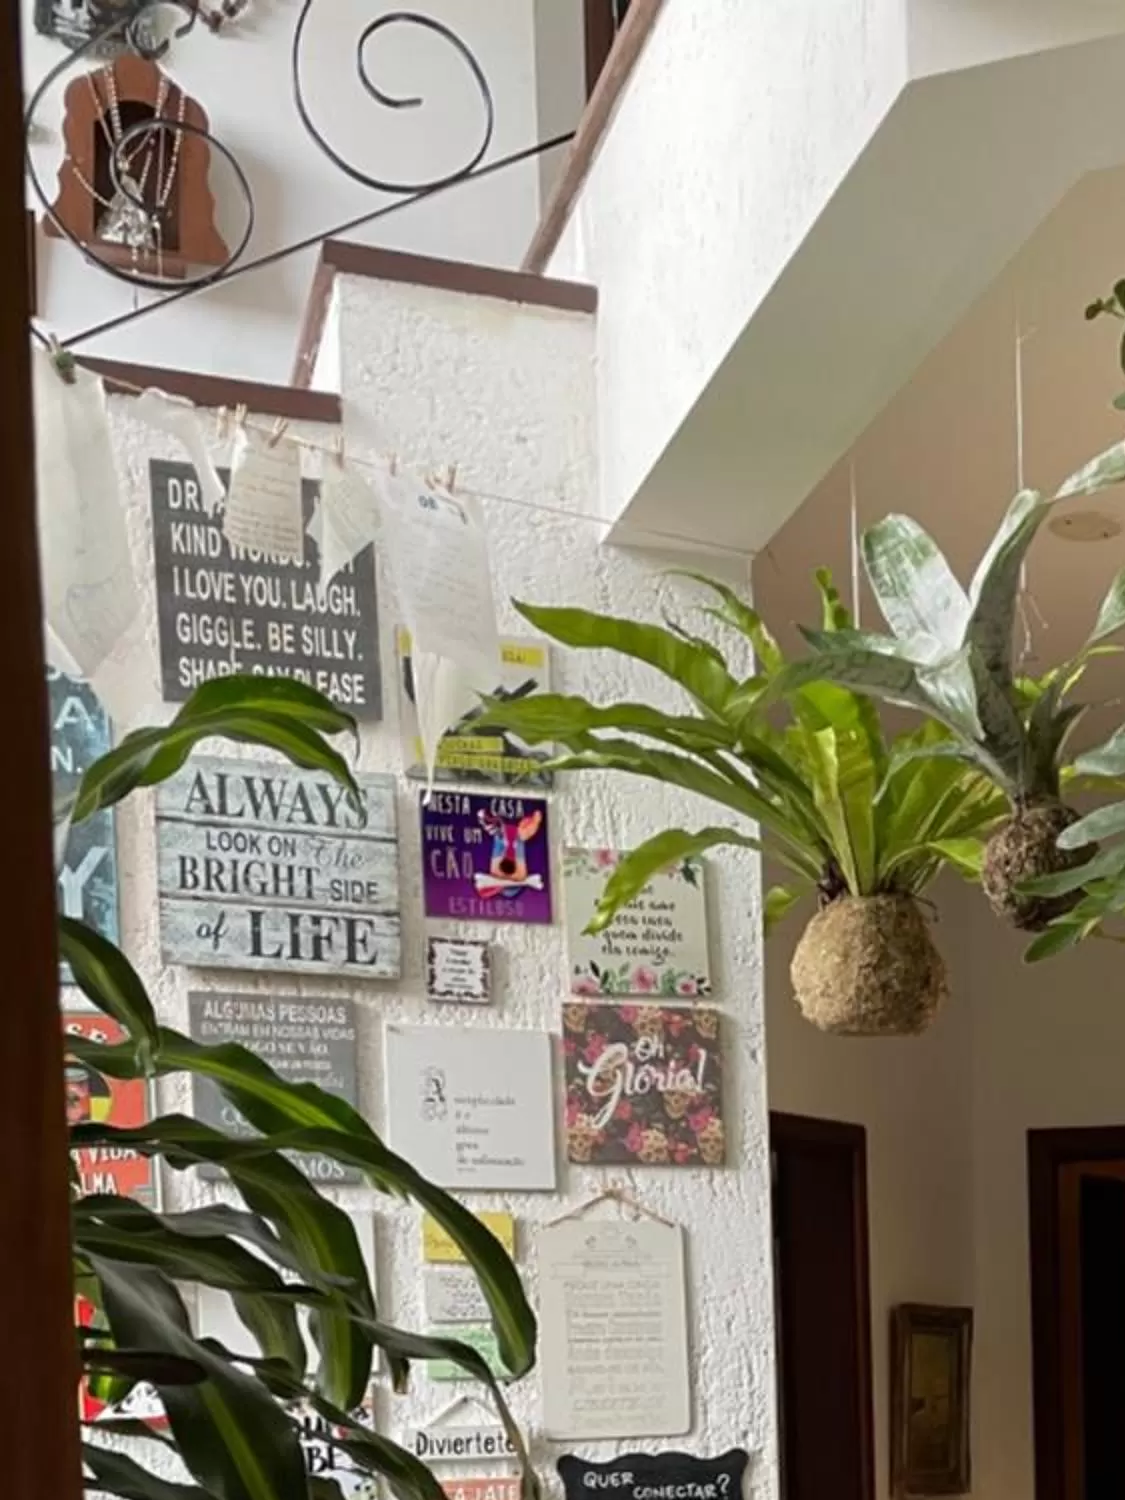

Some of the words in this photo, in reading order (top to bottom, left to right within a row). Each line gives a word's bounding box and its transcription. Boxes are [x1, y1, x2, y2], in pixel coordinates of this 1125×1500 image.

[170, 521, 222, 558] KIND
[173, 566, 180, 596] I
[184, 568, 237, 604] LOVE
[239, 573, 287, 610] YOU.
[175, 612, 262, 650] GIGGLE.
[268, 621, 296, 655] BE
[301, 623, 364, 662] SILLY.
[490, 797, 525, 819] CASA
[205, 830, 262, 856] LOOK
[267, 835, 297, 858] ON
[177, 854, 320, 900] BRIGHT
[329, 878, 379, 904] SIDE
[196, 910, 229, 951] of
[248, 909, 378, 966] LIFE
[278, 1004, 348, 1025] PESSOAS
[583, 1470, 635, 1490] QUER
[632, 1472, 731, 1500] CONECTAR?
